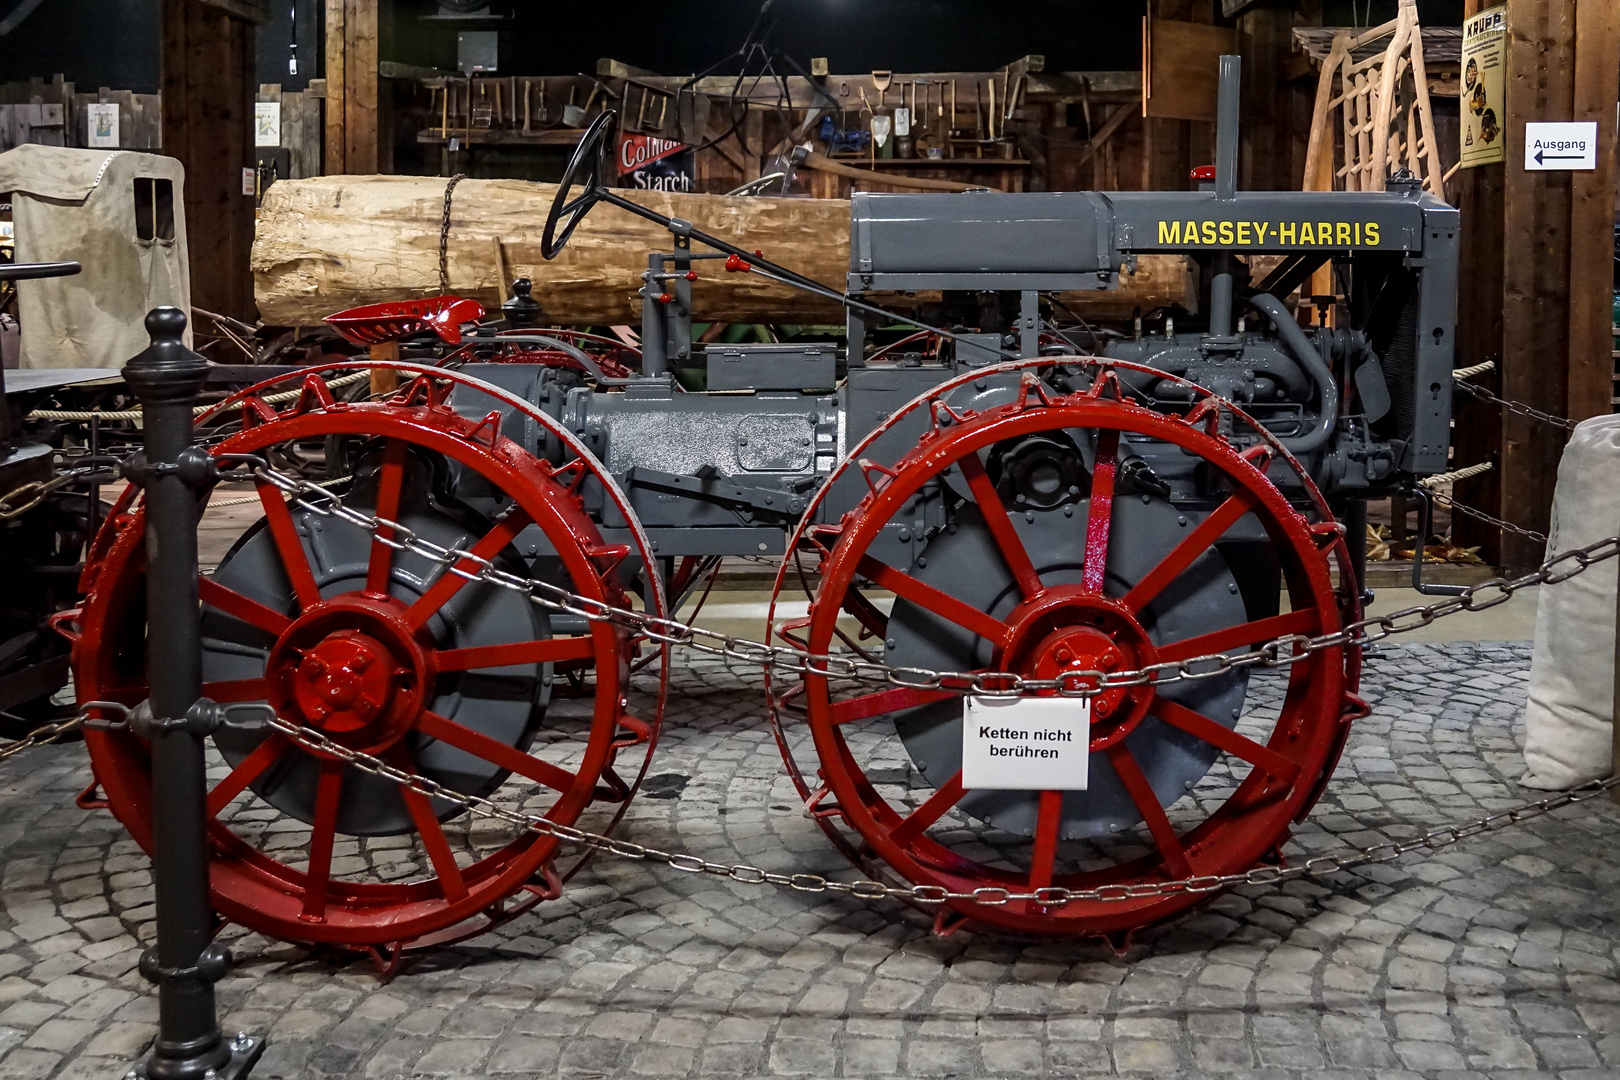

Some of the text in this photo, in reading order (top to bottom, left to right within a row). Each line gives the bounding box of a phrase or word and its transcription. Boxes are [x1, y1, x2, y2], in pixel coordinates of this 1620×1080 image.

[1467, 12, 1501, 38] KRUPP
[1533, 139, 1586, 151] Ausgang
[633, 170, 689, 192] Starch
[1157, 220, 1381, 246] MASSEY-HARRIS
[979, 726, 1073, 742] Ketten nicht
[989, 744, 1059, 759] berühren
